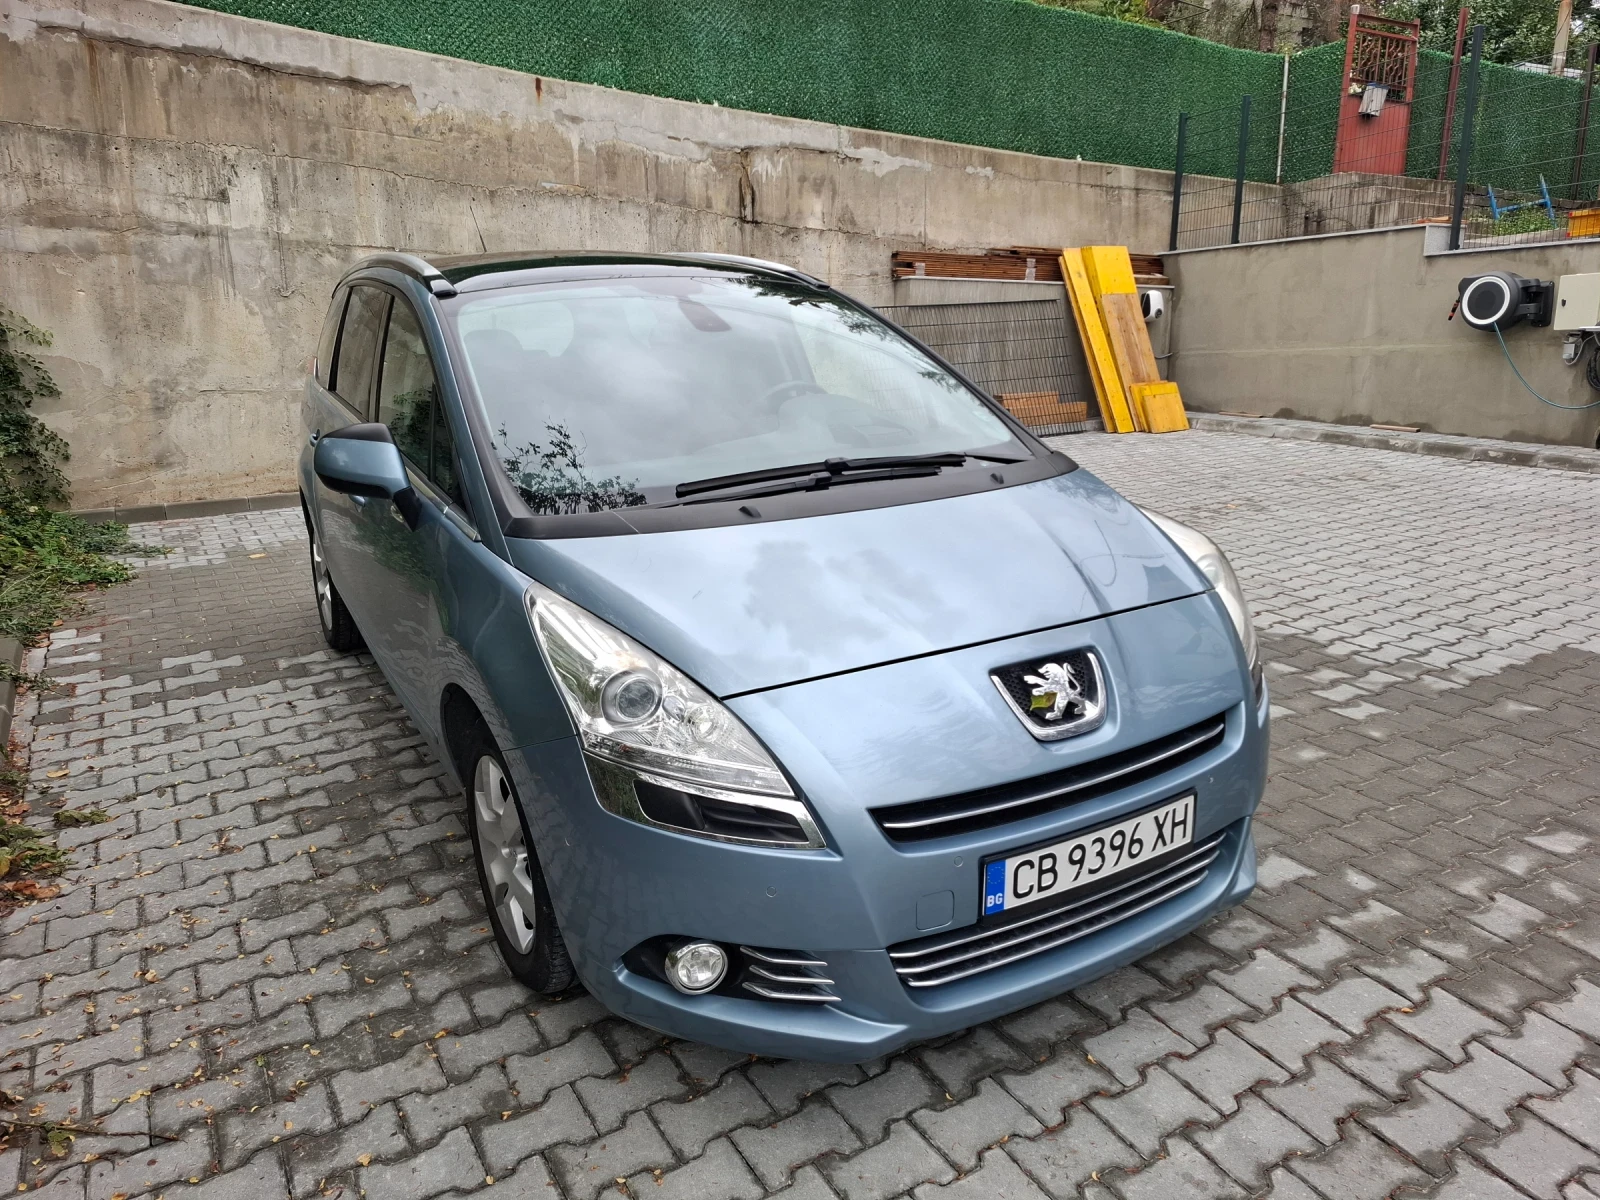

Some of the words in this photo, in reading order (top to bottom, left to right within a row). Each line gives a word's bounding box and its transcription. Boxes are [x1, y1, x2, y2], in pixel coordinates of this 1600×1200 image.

[1013, 853, 1058, 899] CB
[1068, 822, 1143, 882] 9396
[1152, 803, 1188, 851] XH
[987, 893, 1003, 908] BG
